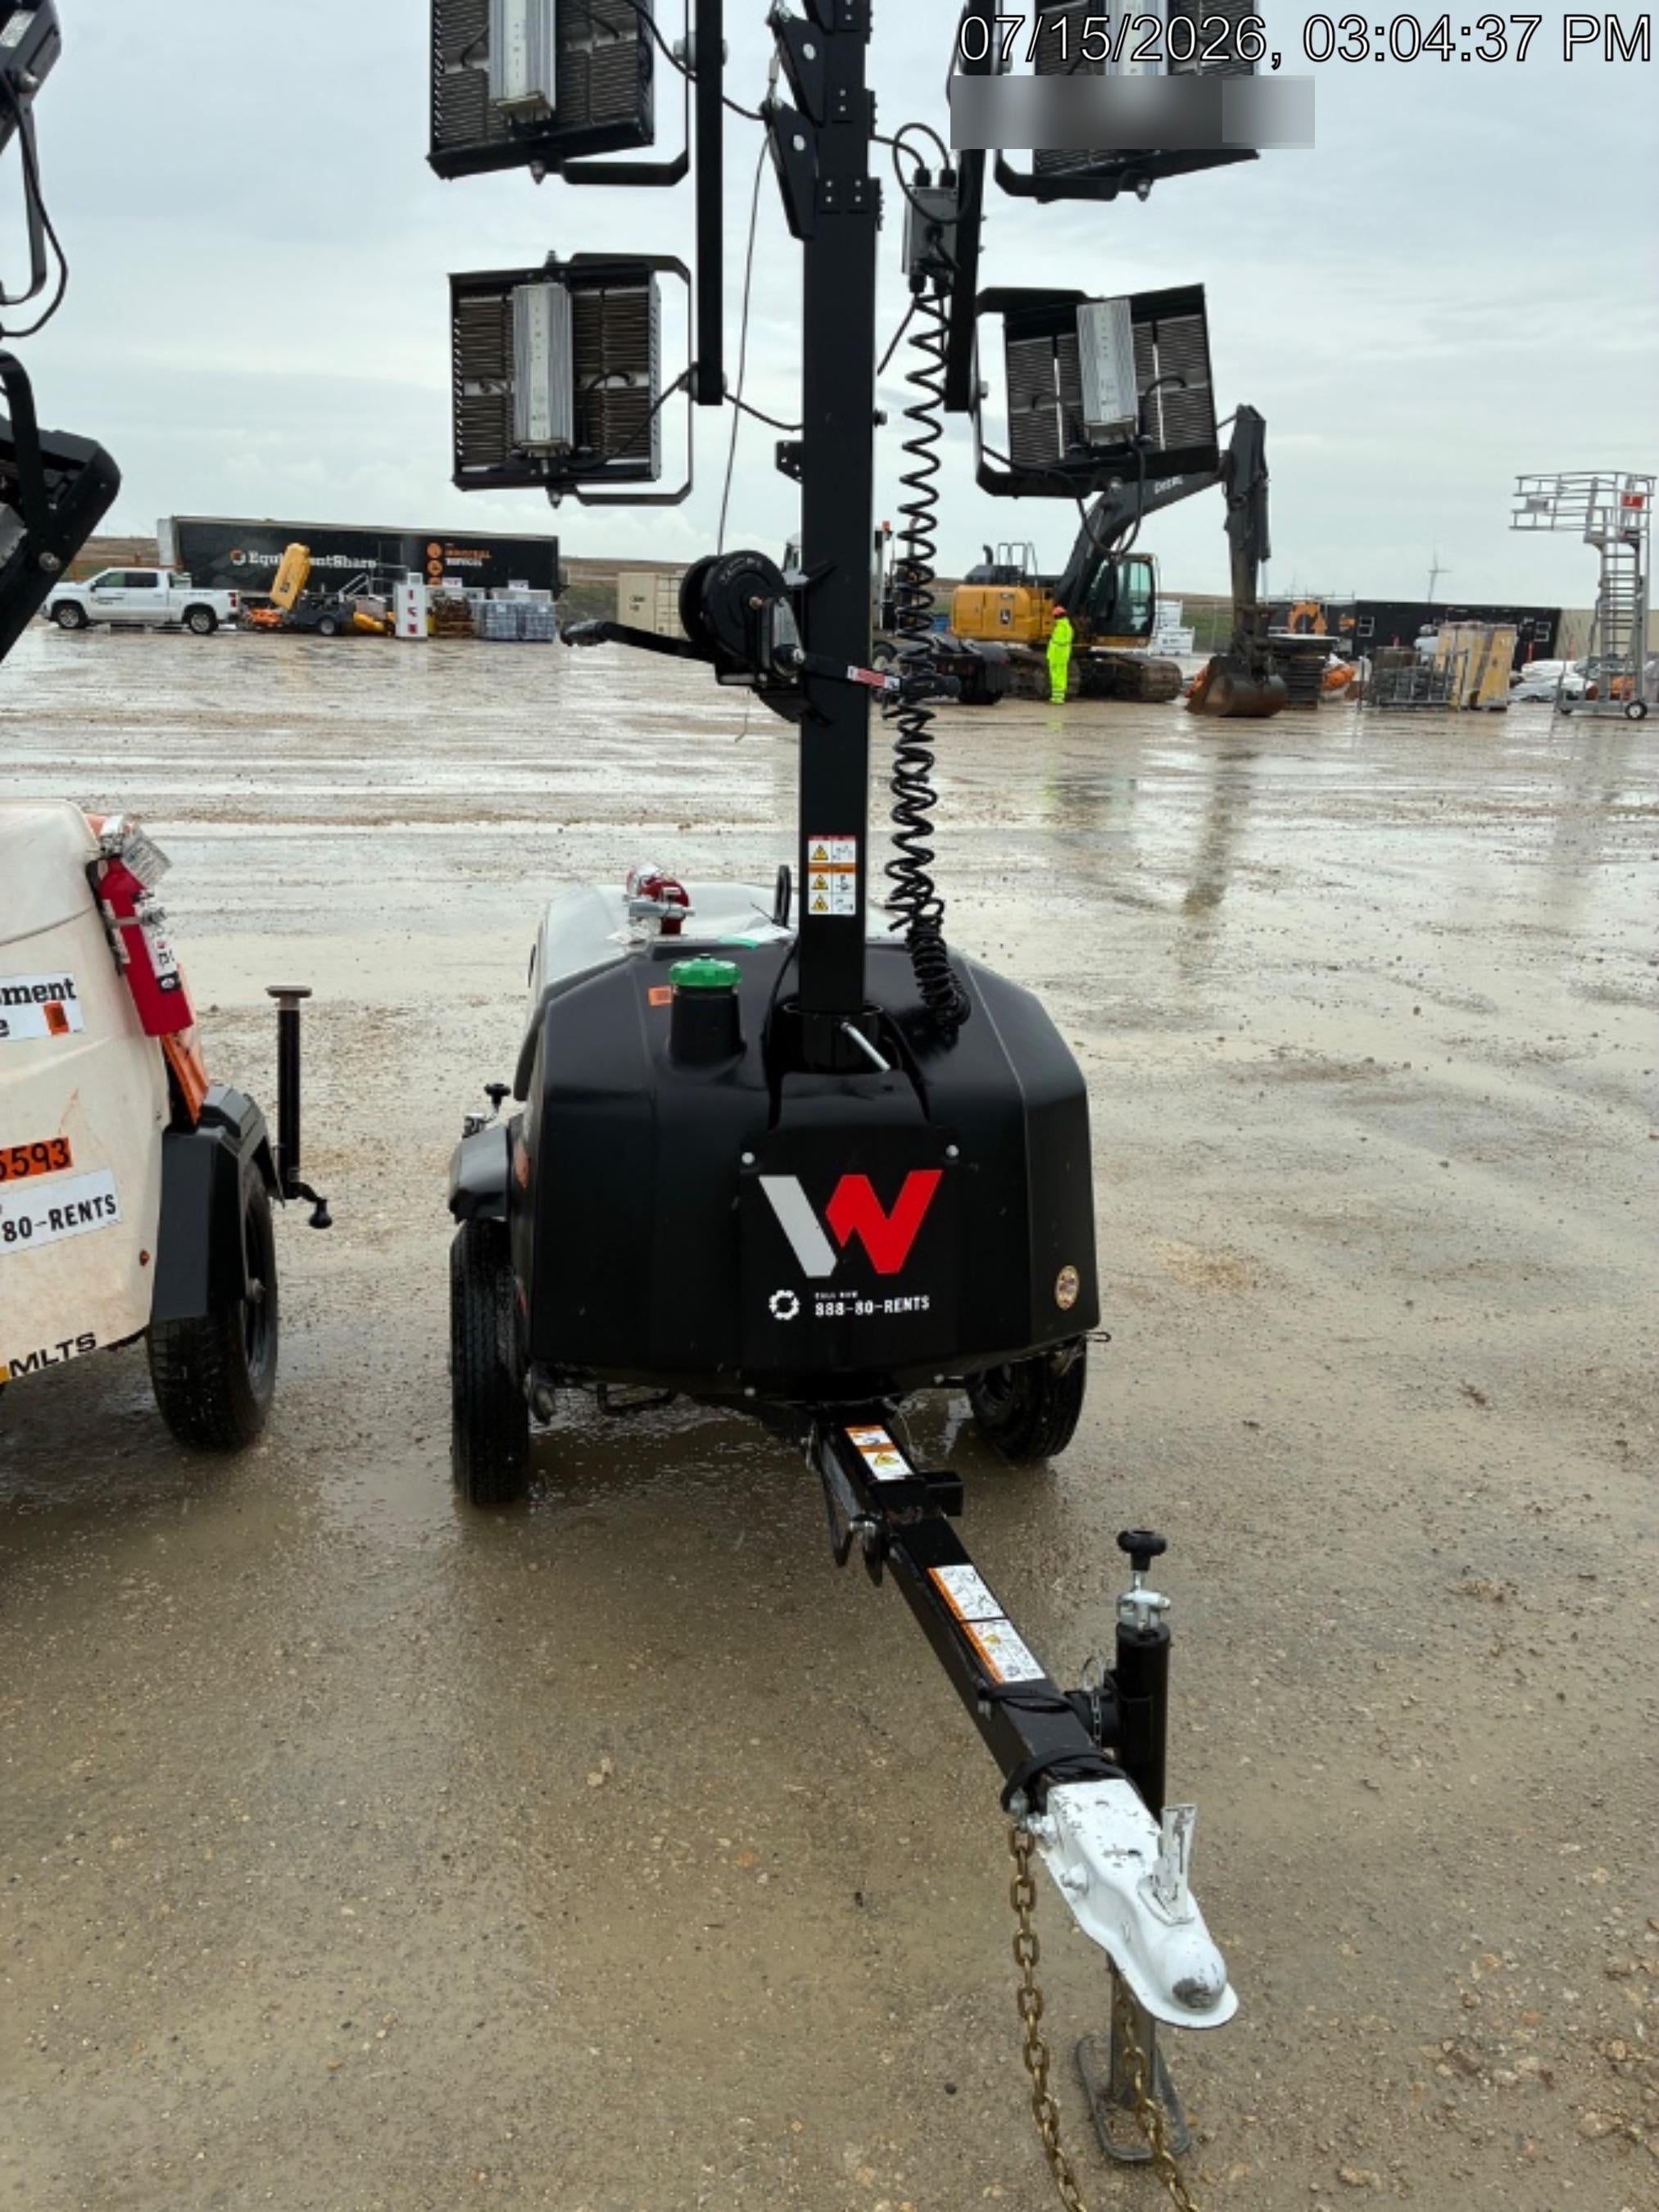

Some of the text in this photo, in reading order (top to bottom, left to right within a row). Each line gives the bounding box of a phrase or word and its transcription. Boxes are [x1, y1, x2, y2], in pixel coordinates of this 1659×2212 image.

[0, 977, 76, 1006] ment
[815, 1294, 931, 1317] 888-80-RENTS
[9, 1331, 96, 1376] MLTS
